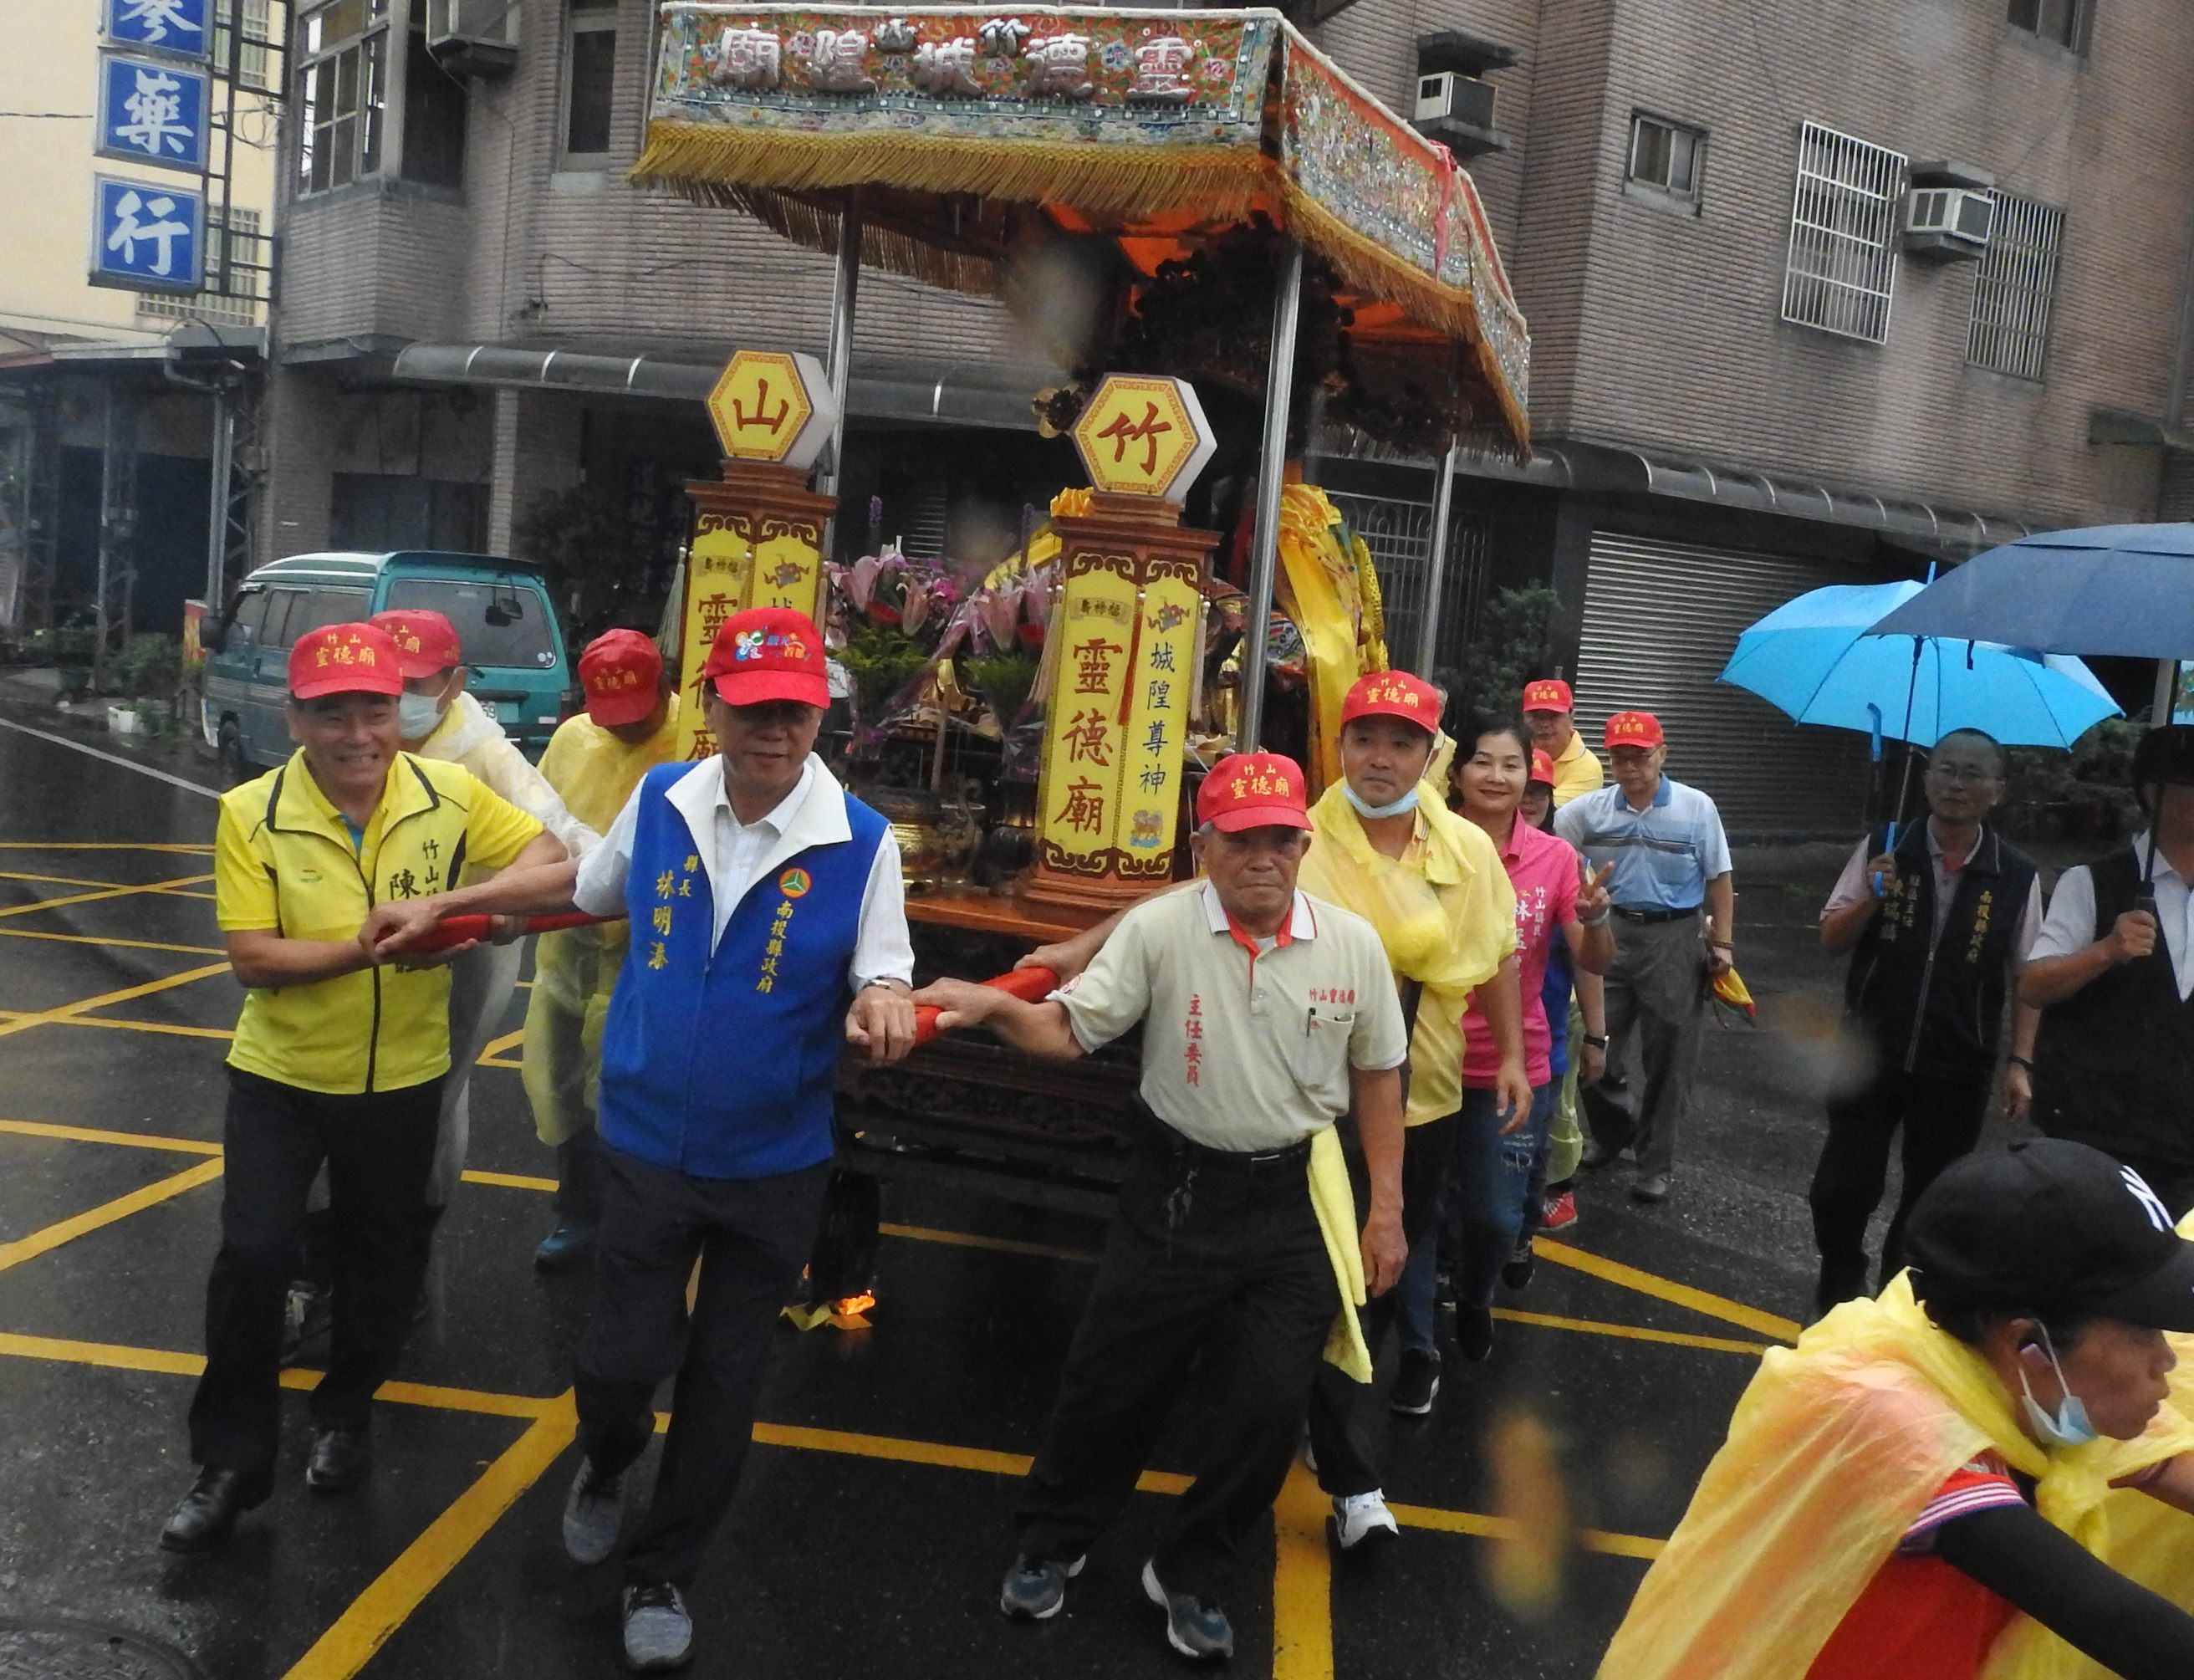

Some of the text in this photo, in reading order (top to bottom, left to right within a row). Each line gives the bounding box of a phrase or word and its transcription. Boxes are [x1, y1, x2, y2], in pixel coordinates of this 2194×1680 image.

[732, 378, 790, 436] 山
[1097, 401, 1171, 476] 竹
[316, 645, 376, 667] 靈德廟
[327, 633, 361, 645] 竹山
[1054, 637, 1123, 835] 靈德廟
[1139, 641, 1176, 795] 城隍尊神
[1231, 775, 1289, 799] 靈德廟
[1243, 763, 1277, 776] 竹山
[390, 868, 421, 901] 陳
[422, 839, 440, 896] 竹山
[756, 900, 793, 993] 南投縣政府
[1184, 993, 1203, 1087] 主任委員
